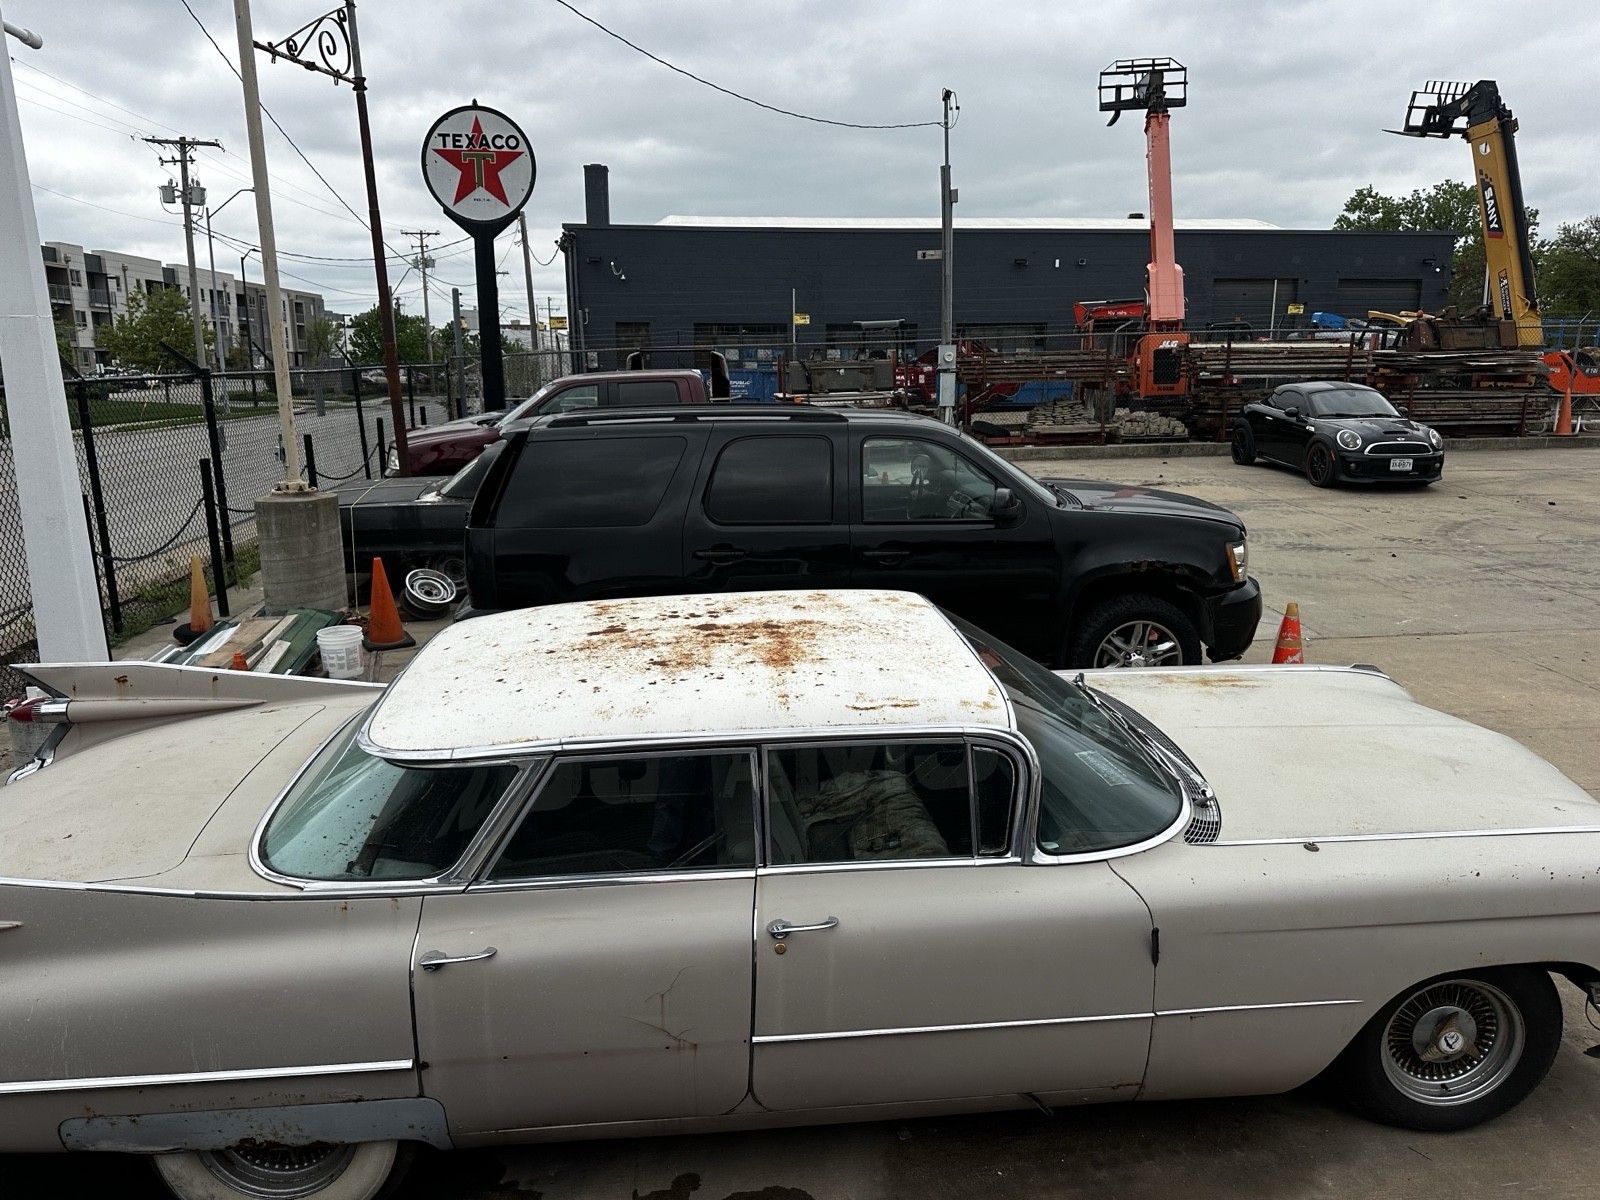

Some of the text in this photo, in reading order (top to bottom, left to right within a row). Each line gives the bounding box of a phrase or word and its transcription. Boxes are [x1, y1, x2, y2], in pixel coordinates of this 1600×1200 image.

[437, 132, 520, 151] TEXACO
[1484, 186, 1499, 229] SANY
[1159, 340, 1179, 348] JLG
